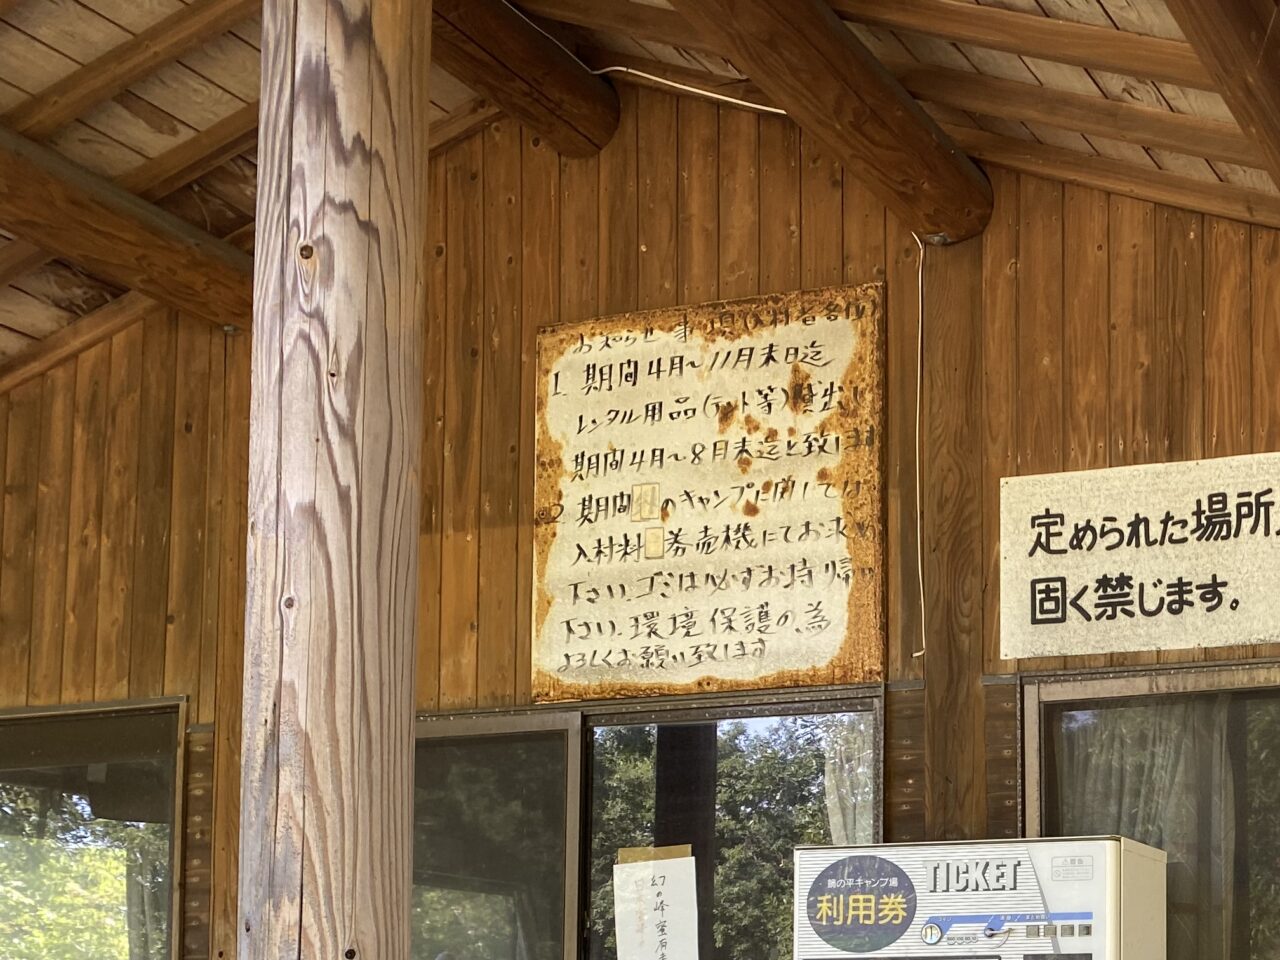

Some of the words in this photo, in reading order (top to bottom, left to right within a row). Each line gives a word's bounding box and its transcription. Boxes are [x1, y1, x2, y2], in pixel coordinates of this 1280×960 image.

[1030, 572, 1241, 626] 固く禁じます。
[923, 858, 1021, 893] TICKET
[816, 893, 907, 926] 利用券
